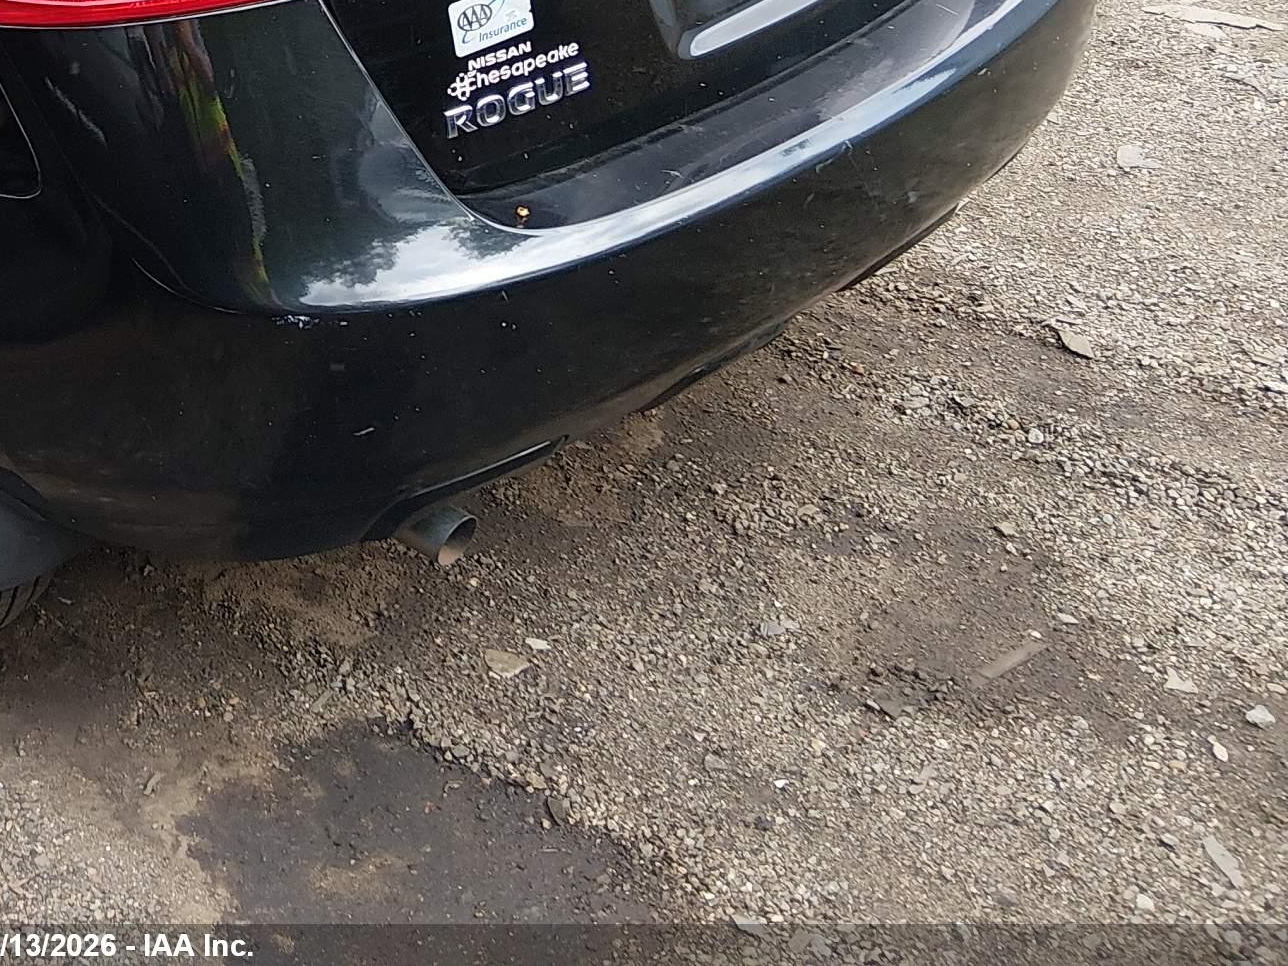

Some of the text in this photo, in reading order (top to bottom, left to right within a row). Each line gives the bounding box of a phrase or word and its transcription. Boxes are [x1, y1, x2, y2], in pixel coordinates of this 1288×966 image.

[459, 5, 491, 30] AAA
[479, 17, 528, 43] Insurance
[460, 42, 580, 92] Chesapeake
[468, 41, 532, 71] NISSAN
[443, 62, 591, 139] ROGUE
